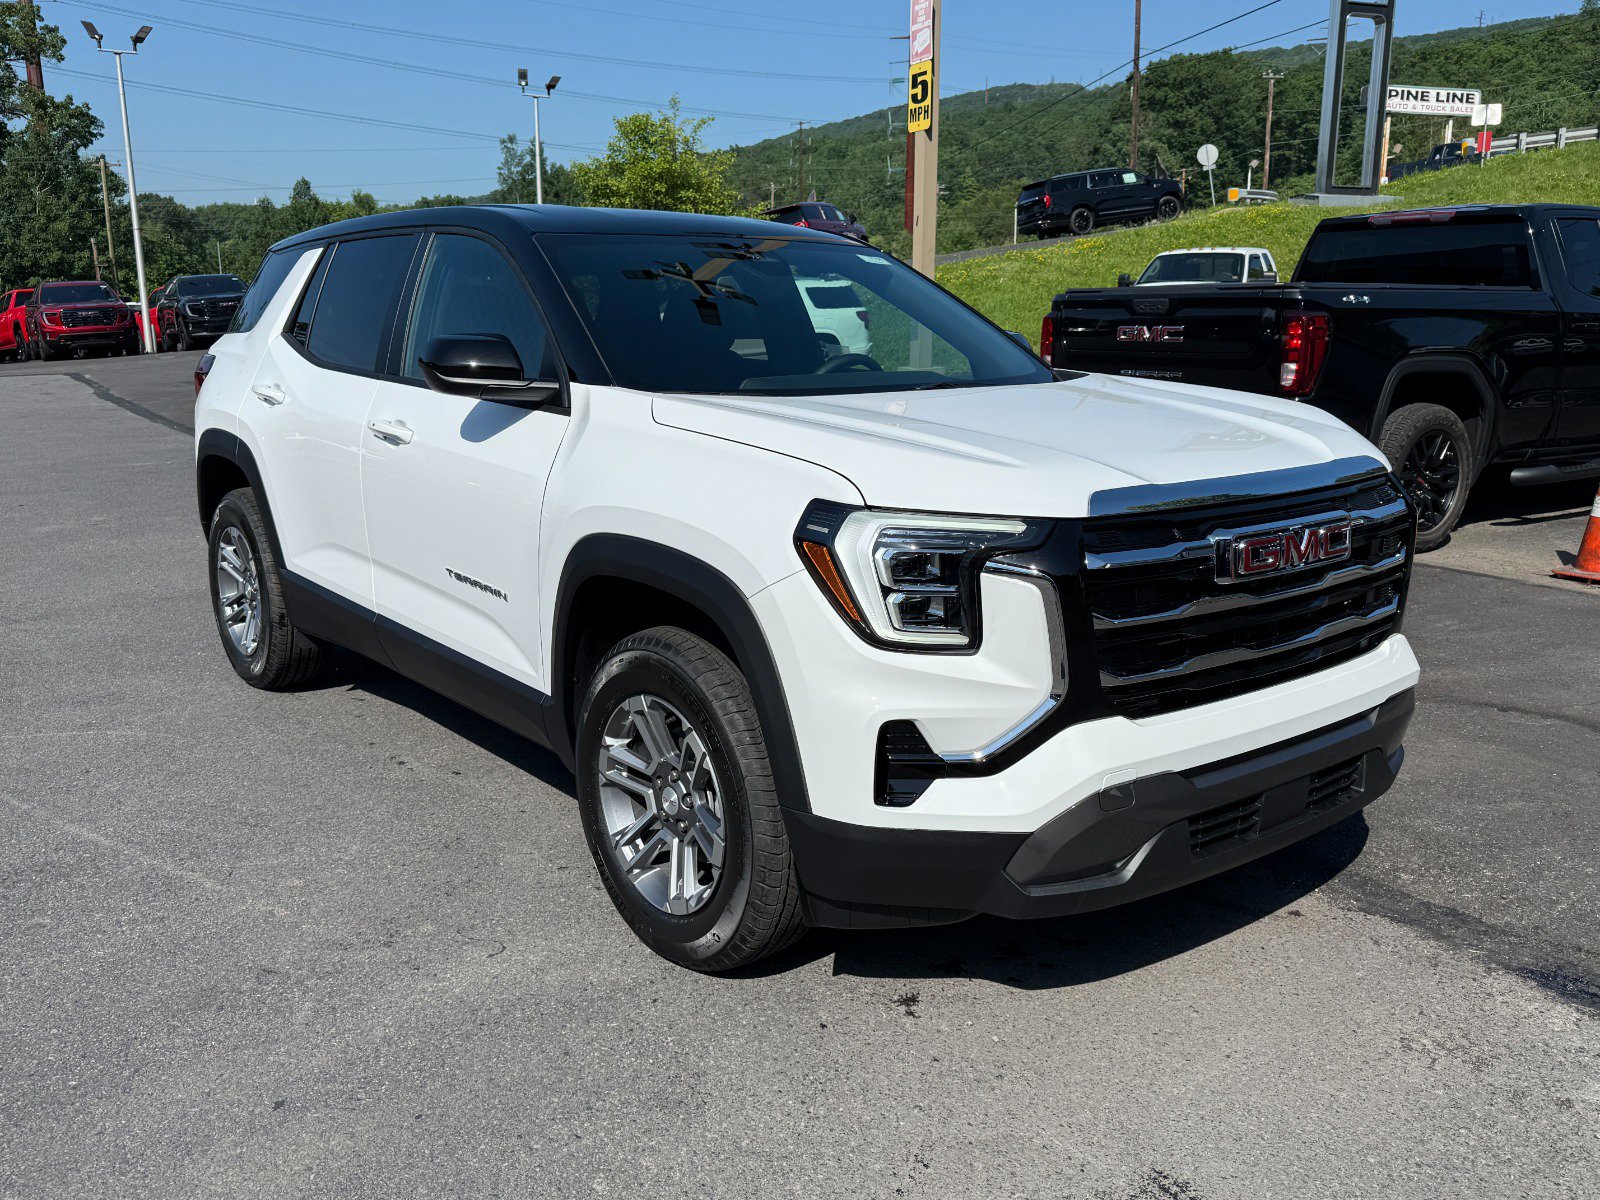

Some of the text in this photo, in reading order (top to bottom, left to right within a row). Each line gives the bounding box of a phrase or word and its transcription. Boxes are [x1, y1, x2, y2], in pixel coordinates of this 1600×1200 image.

[911, 70, 929, 105] 5
[1387, 89, 1476, 104] PINE LINE
[909, 104, 930, 124] MPH
[1386, 102, 1408, 110] AUTO
[1411, 103, 1417, 111] &
[1116, 325, 1184, 342] GMC
[1236, 521, 1352, 575] GMC
[445, 567, 509, 603] TERRAIN
